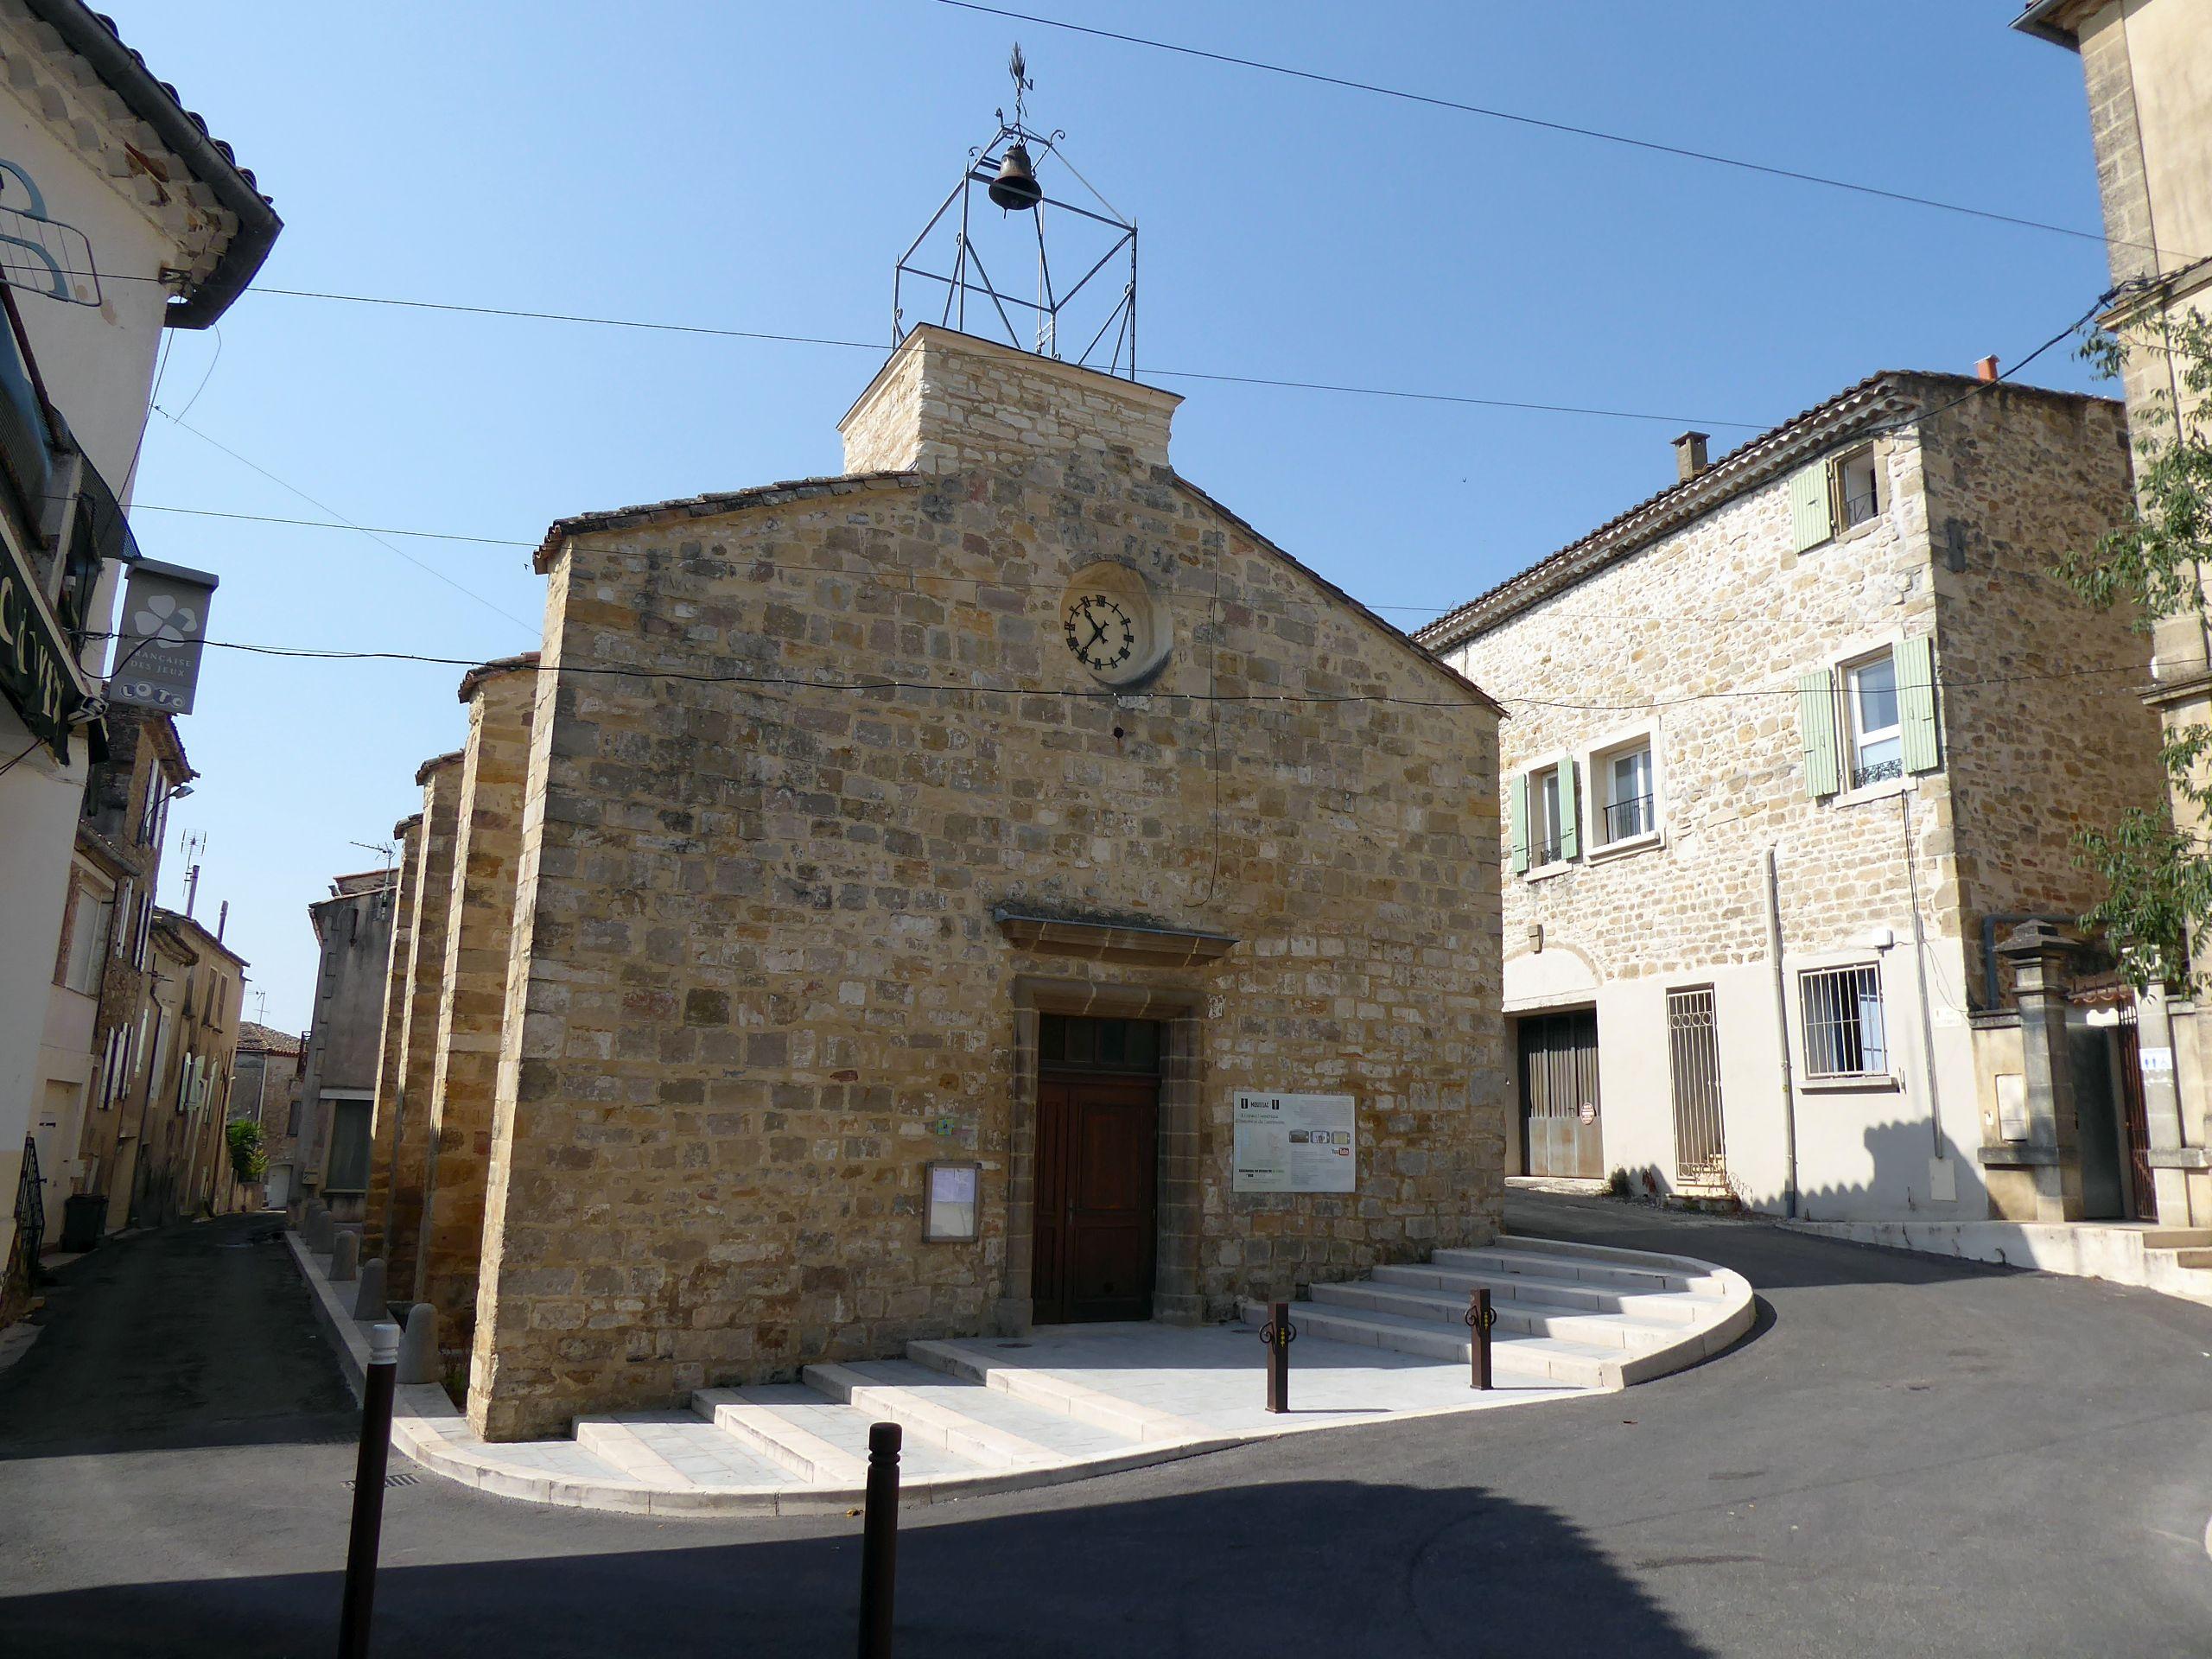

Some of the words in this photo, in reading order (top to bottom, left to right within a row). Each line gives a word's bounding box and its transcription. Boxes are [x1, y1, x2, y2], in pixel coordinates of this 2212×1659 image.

[130, 659, 152, 671] DES
[156, 664, 185, 677] JEUX
[121, 682, 184, 707] LOTO
